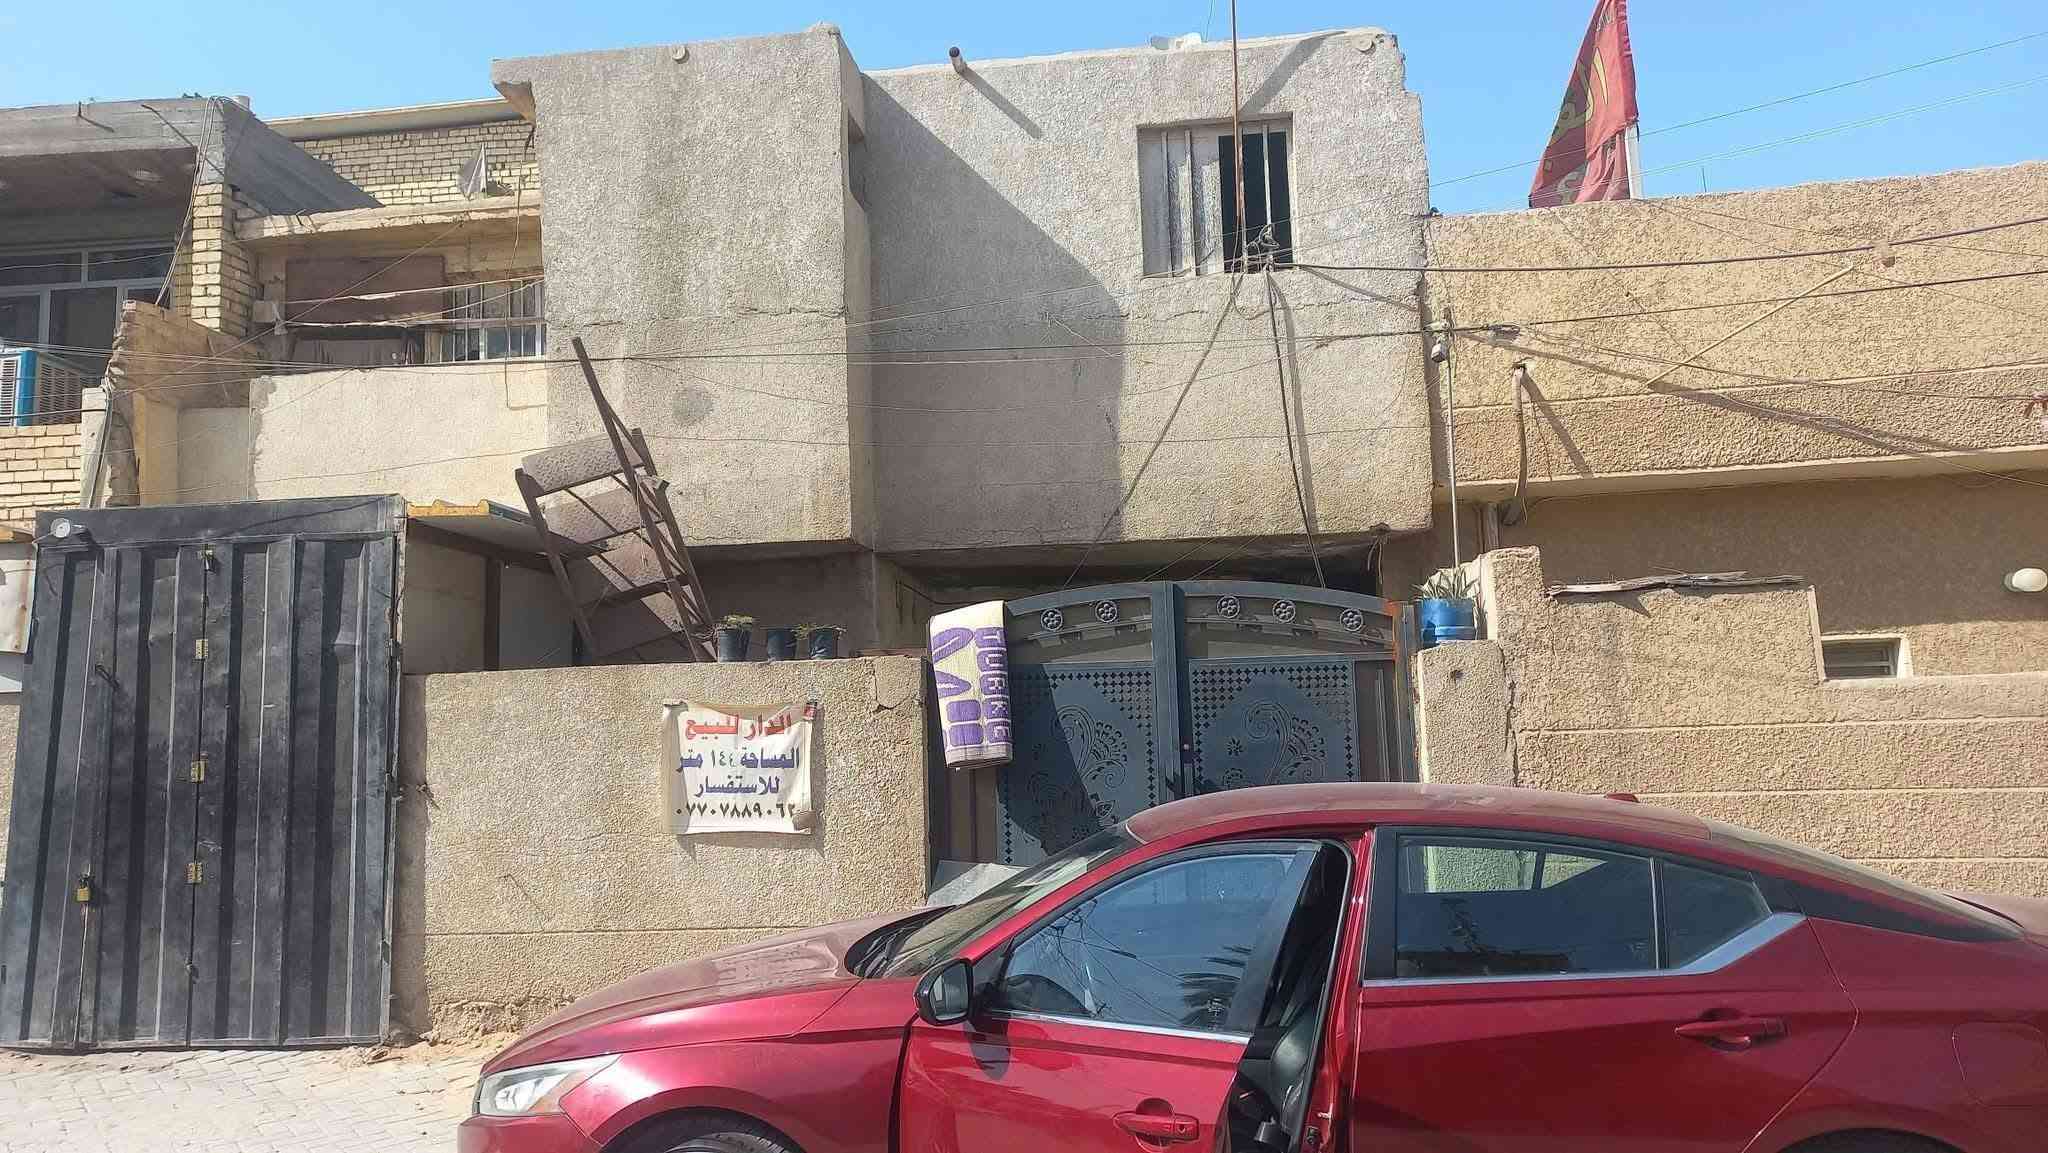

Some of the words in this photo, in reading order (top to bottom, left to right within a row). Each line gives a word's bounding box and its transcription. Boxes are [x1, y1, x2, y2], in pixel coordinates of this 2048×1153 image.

[685, 715, 739, 740] للبيع
[744, 712, 792, 740] الدار
[676, 749, 703, 772] متر
[711, 749, 736, 768] ١٤٤
[739, 746, 800, 769] المساحة
[694, 775, 780, 797] للاستفسار
